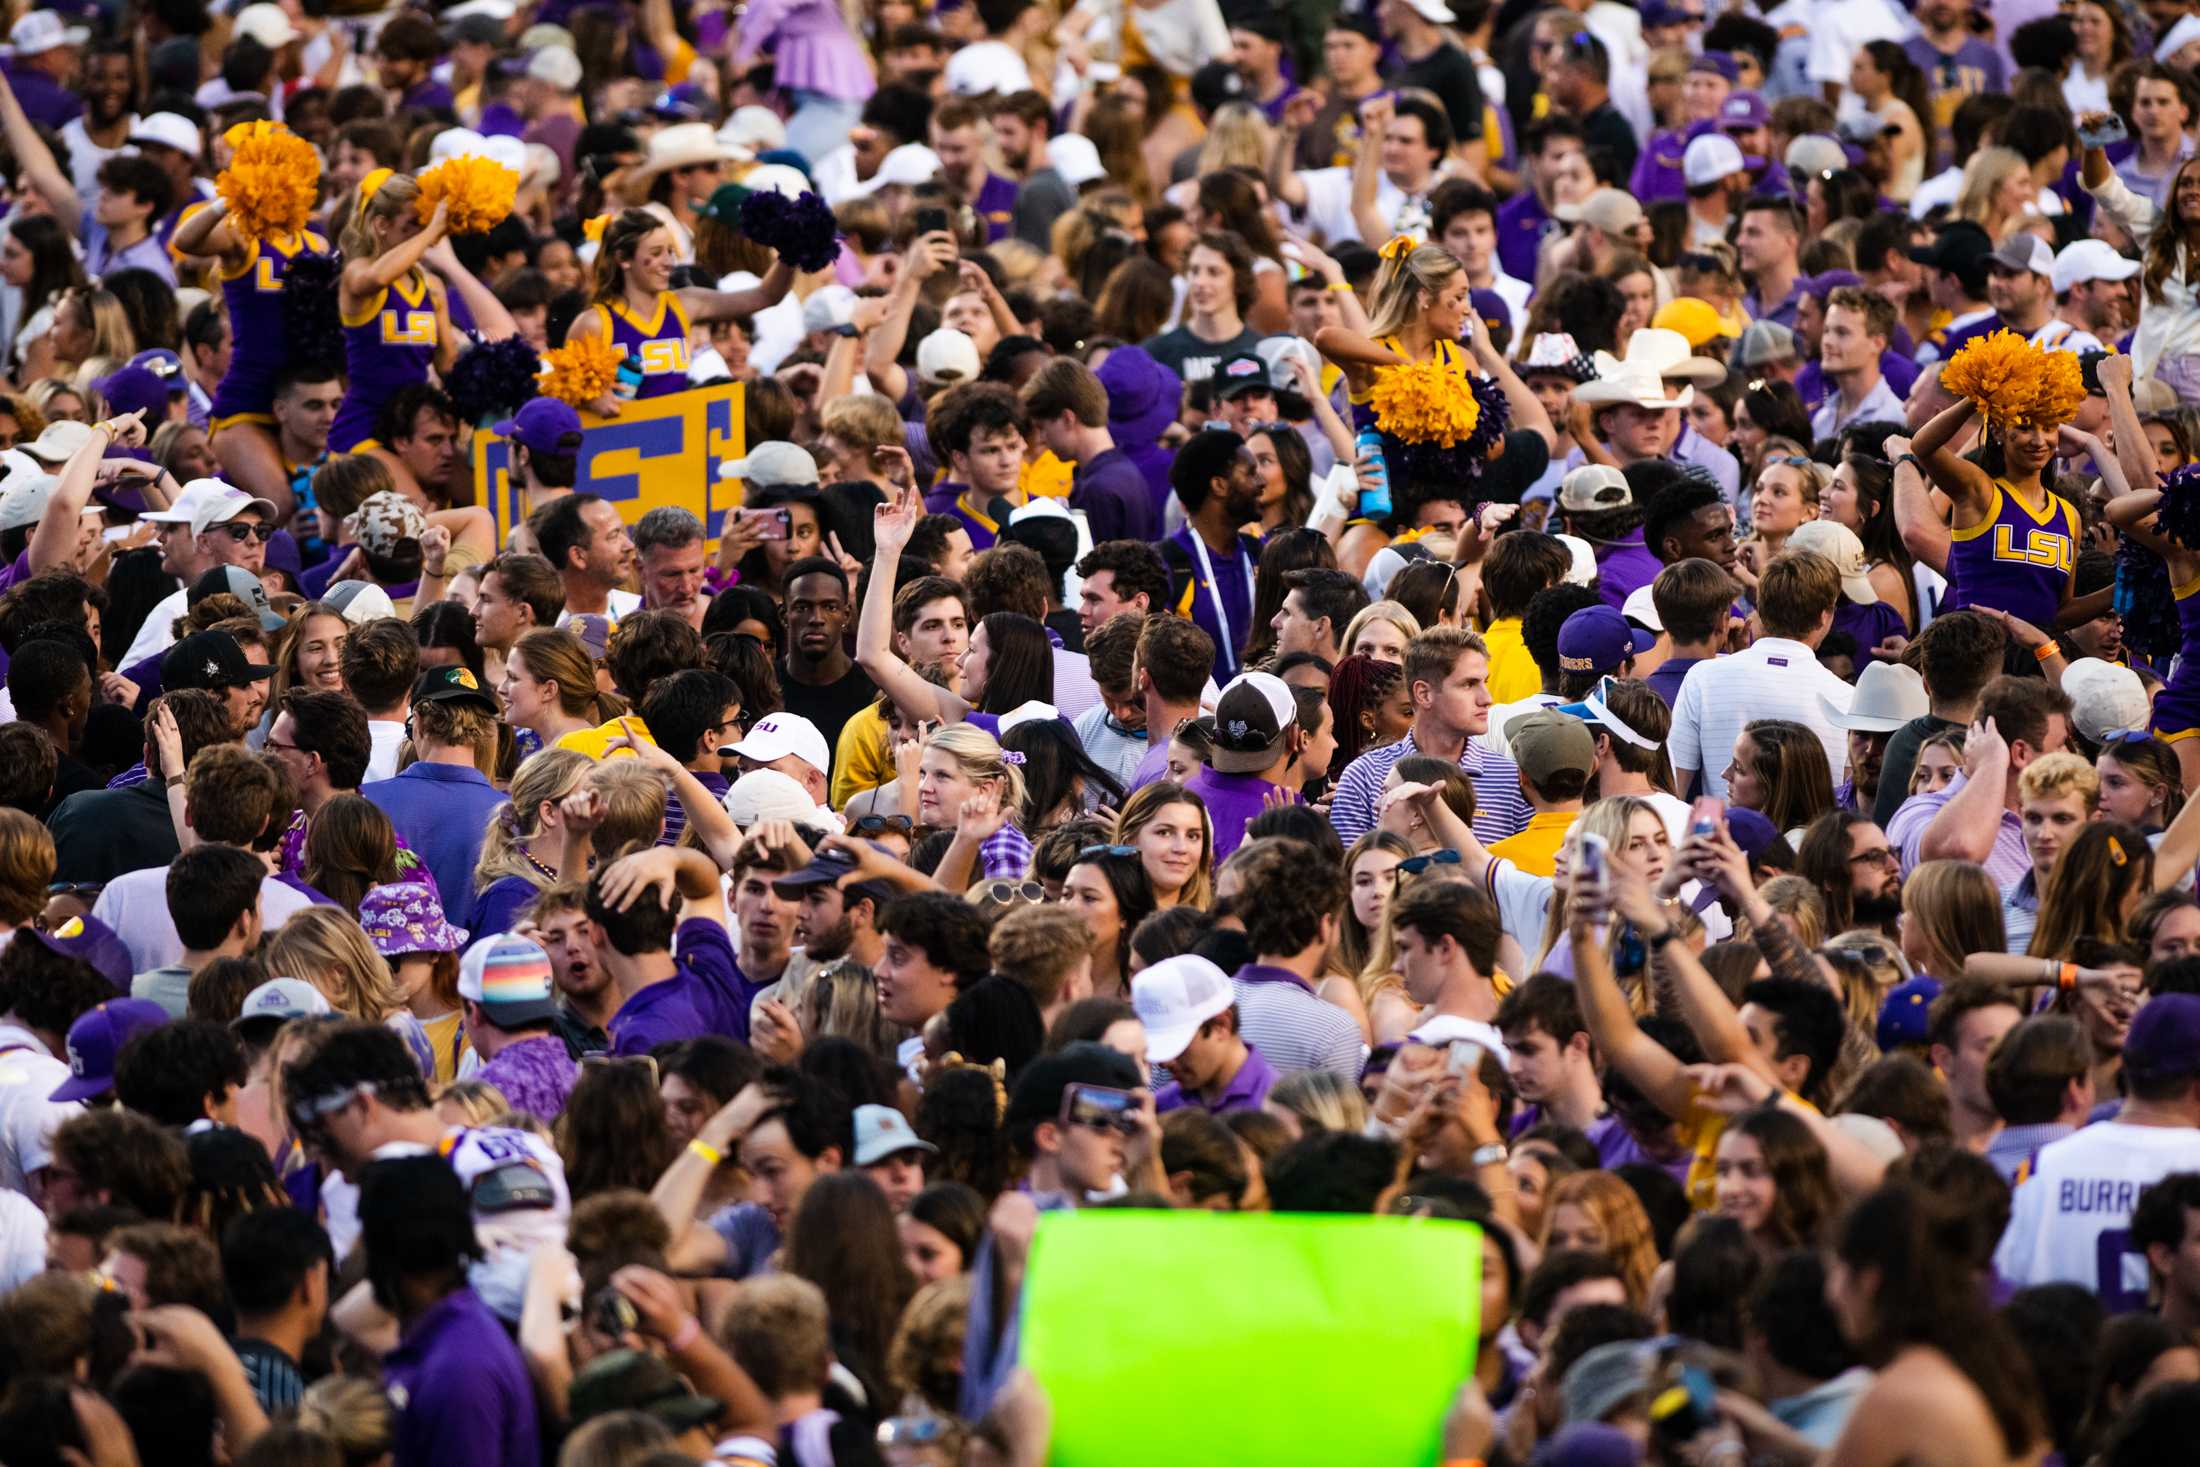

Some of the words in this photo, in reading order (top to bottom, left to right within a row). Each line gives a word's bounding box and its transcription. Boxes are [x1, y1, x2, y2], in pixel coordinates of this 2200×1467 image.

[1992, 523, 2072, 577] LSU
[754, 720, 779, 733] SU
[2060, 1178, 2137, 1214] BURR
